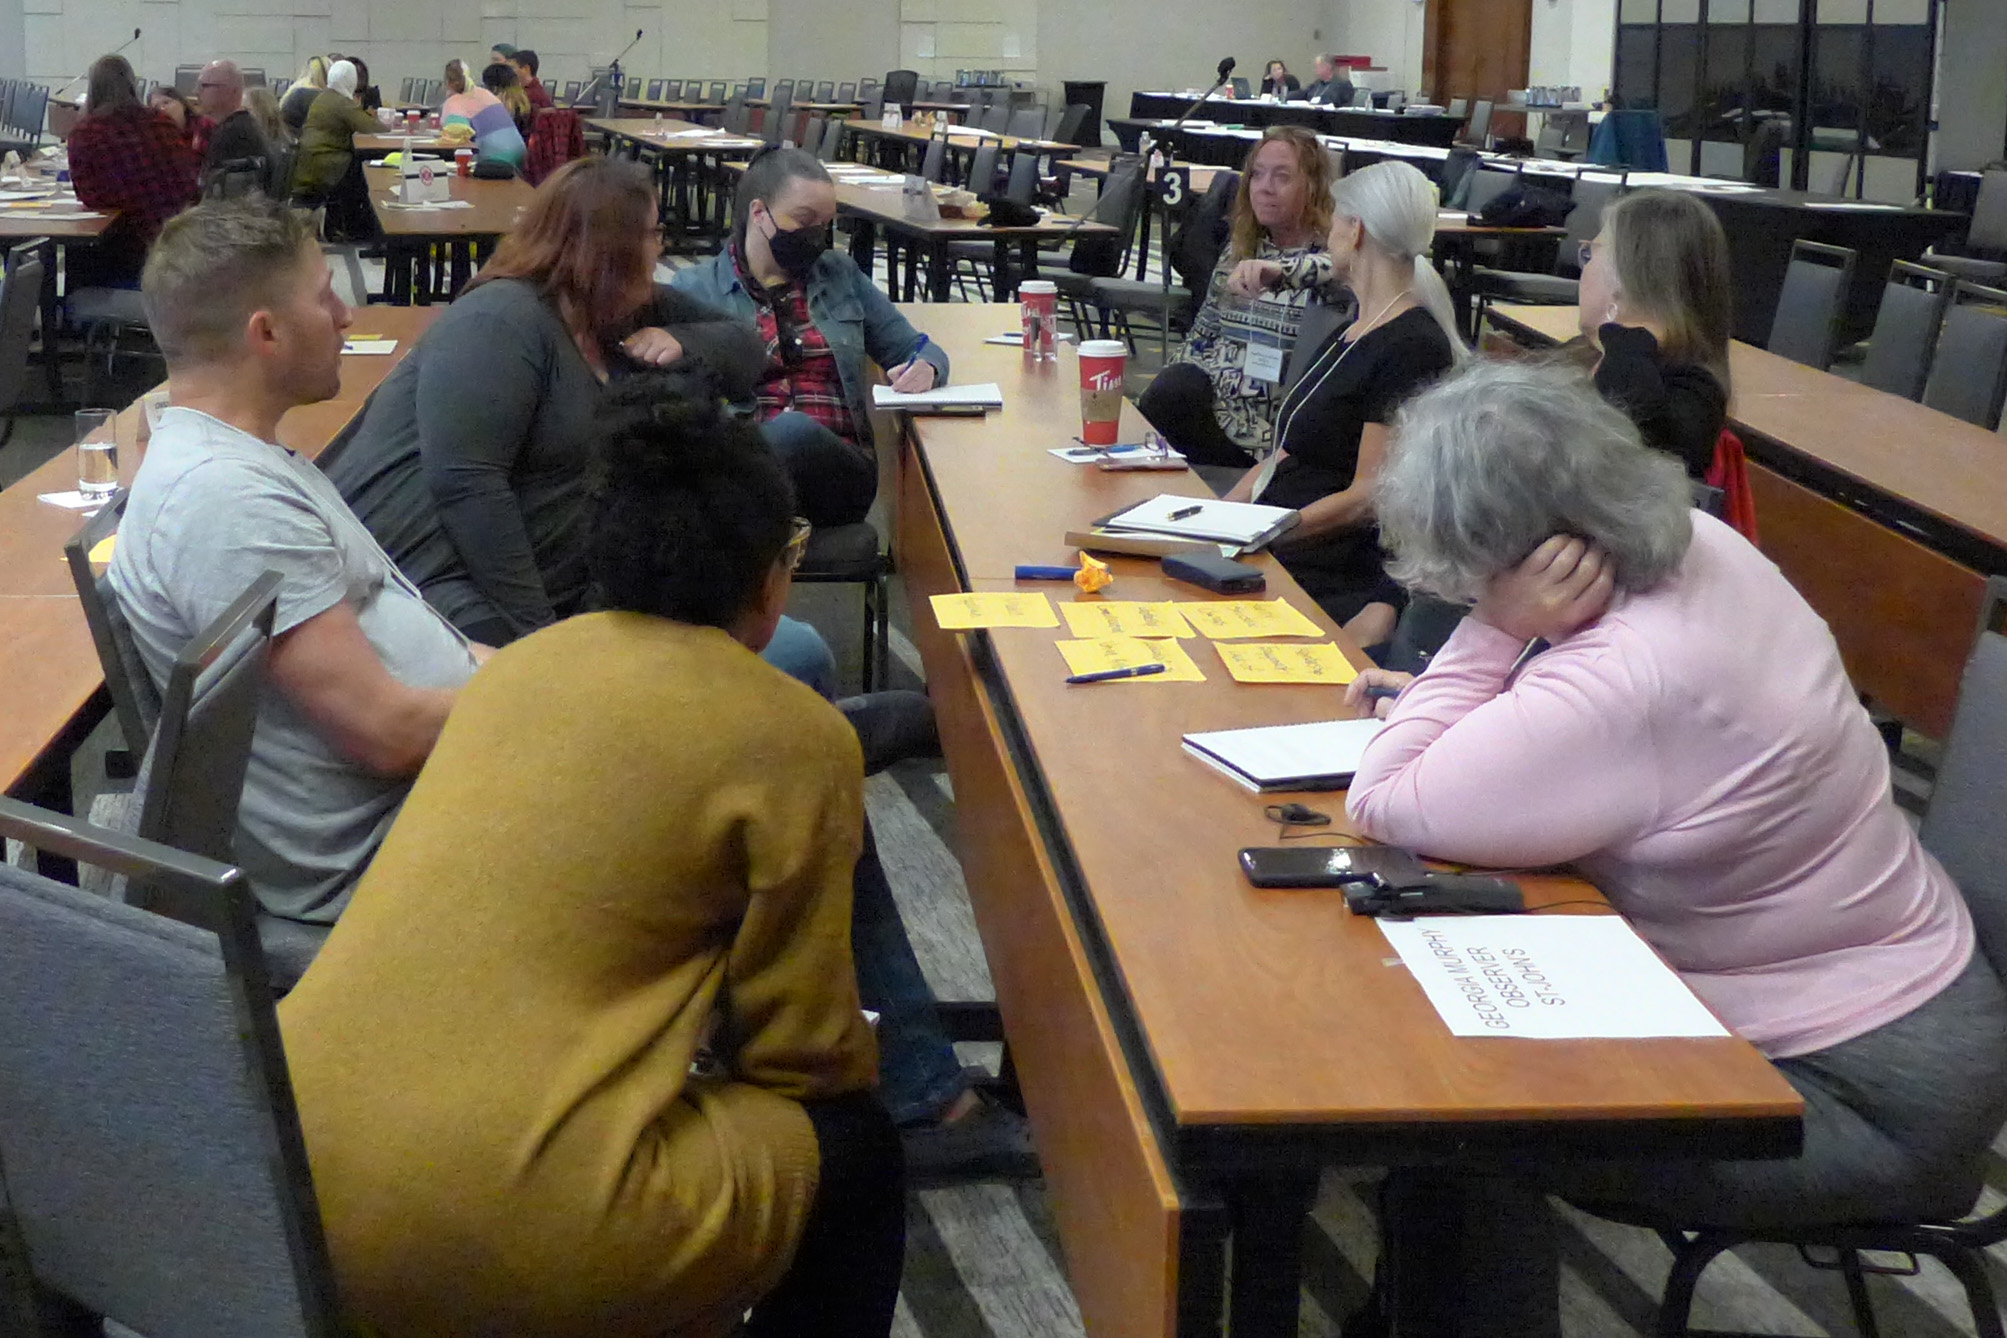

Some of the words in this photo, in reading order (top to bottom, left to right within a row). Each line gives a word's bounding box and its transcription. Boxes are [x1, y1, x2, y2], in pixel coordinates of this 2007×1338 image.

[1162, 171, 1182, 205] 3
[1417, 927, 1470, 974] MURPHY
[1466, 946, 1531, 1008] OBSERVER
[1453, 976, 1510, 1029] GEORGIA
